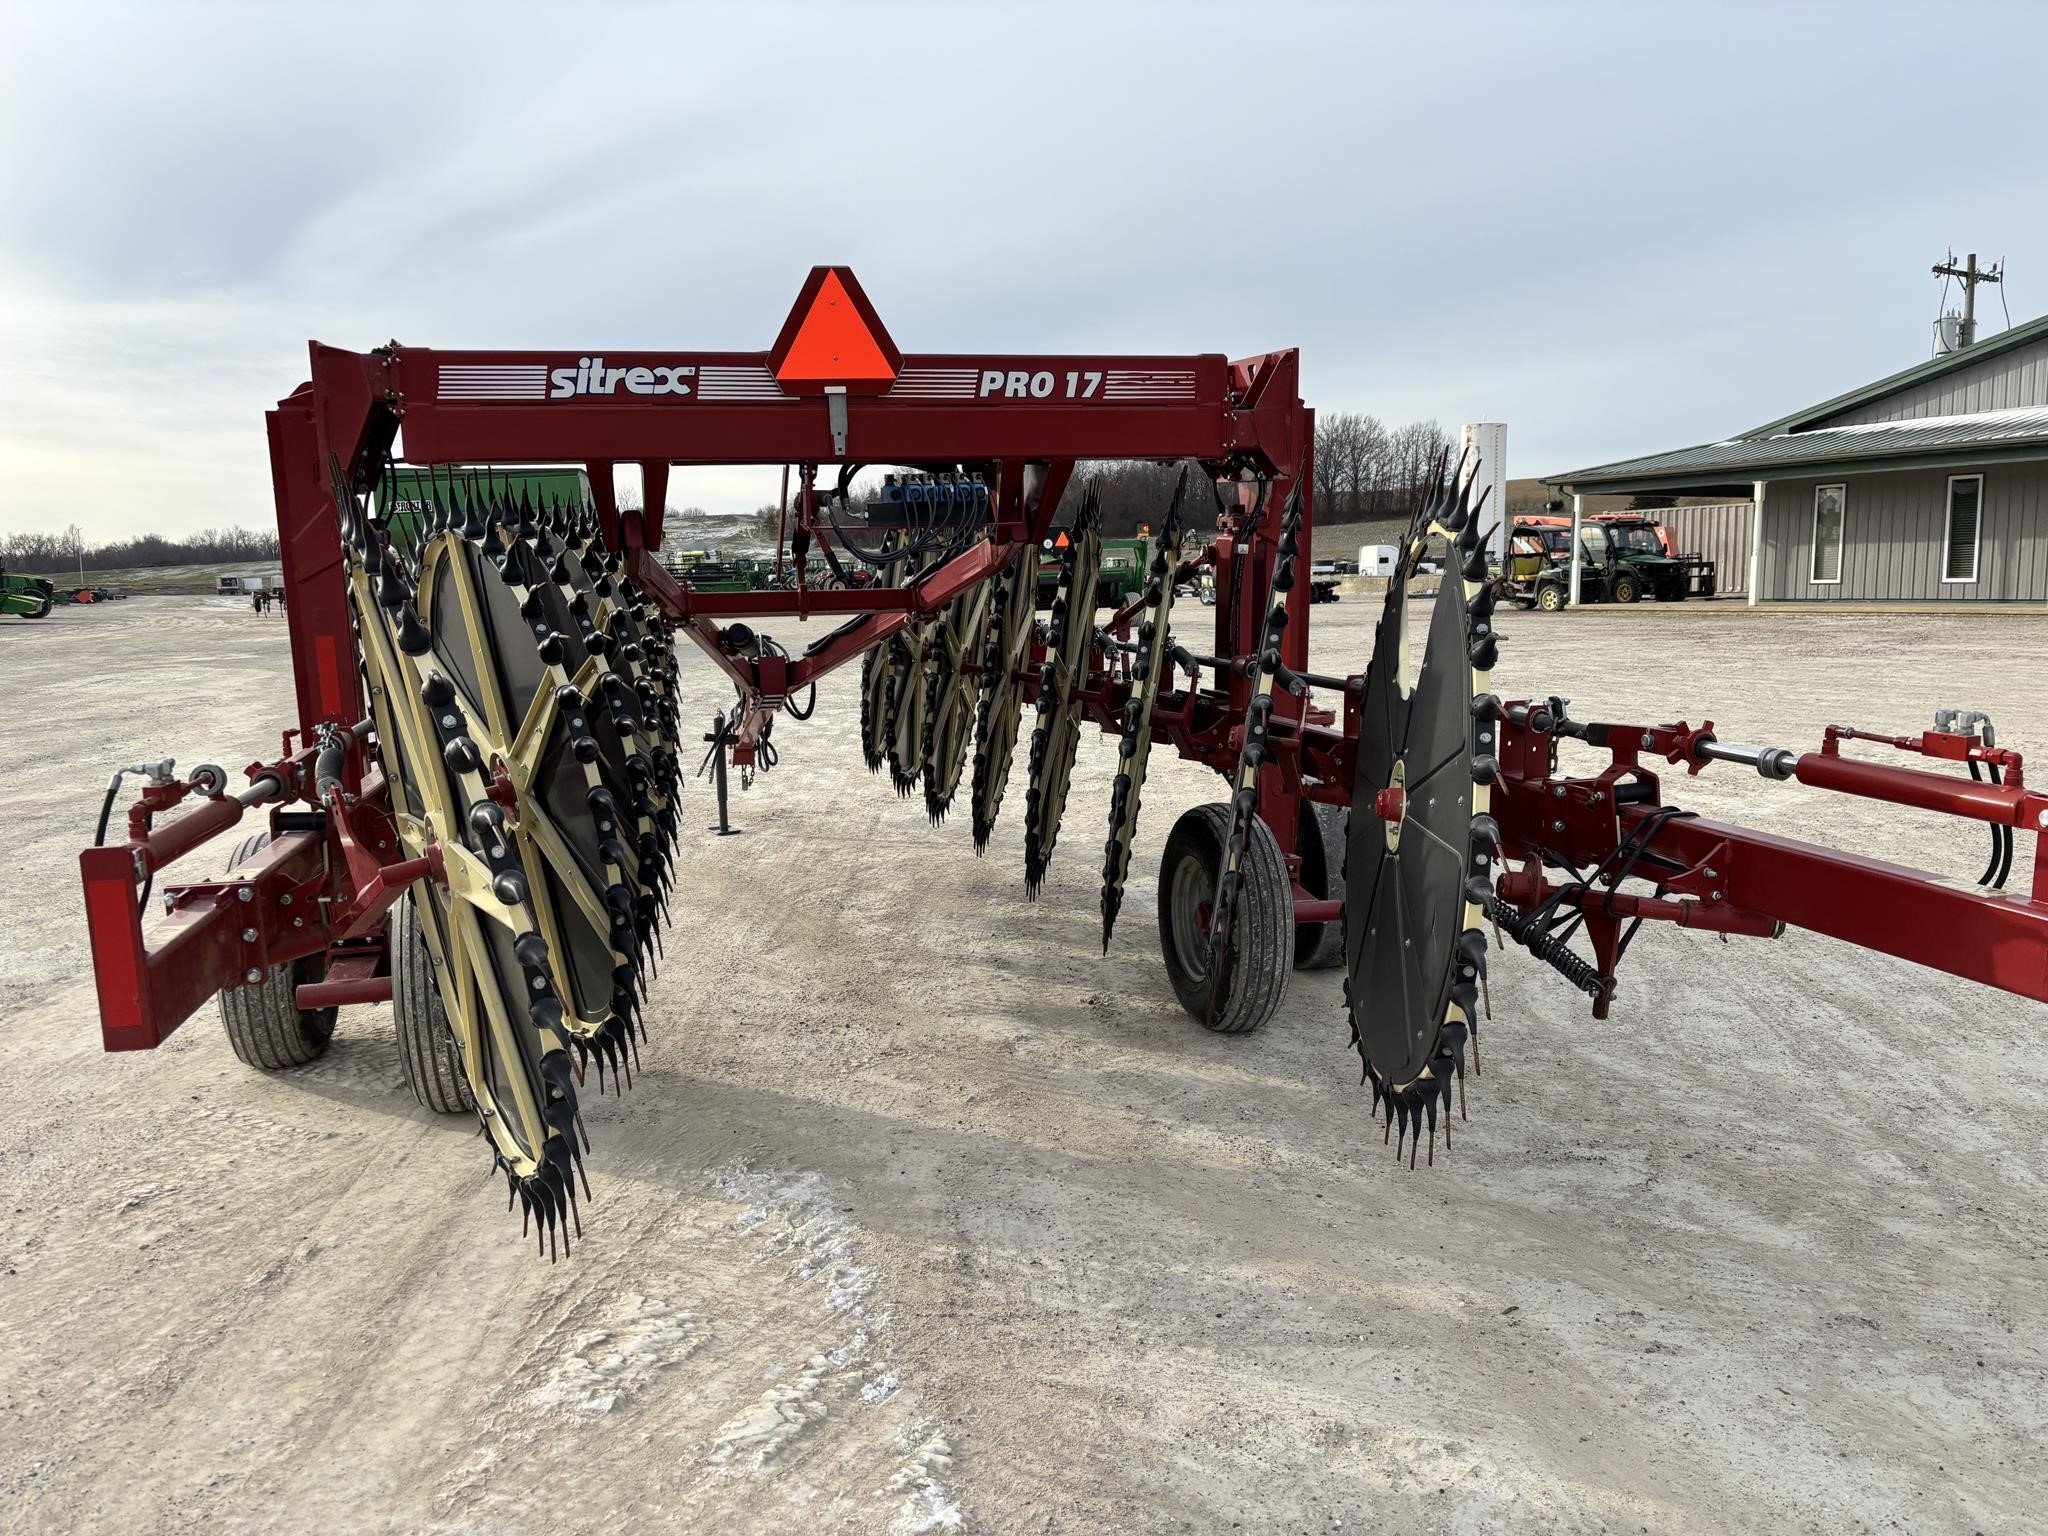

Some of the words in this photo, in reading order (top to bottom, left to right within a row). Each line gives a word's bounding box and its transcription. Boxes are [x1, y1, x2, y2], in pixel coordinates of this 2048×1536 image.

[550, 357, 696, 399] sitrex
[979, 370, 1055, 398] PRO
[1065, 371, 1103, 398] 17
